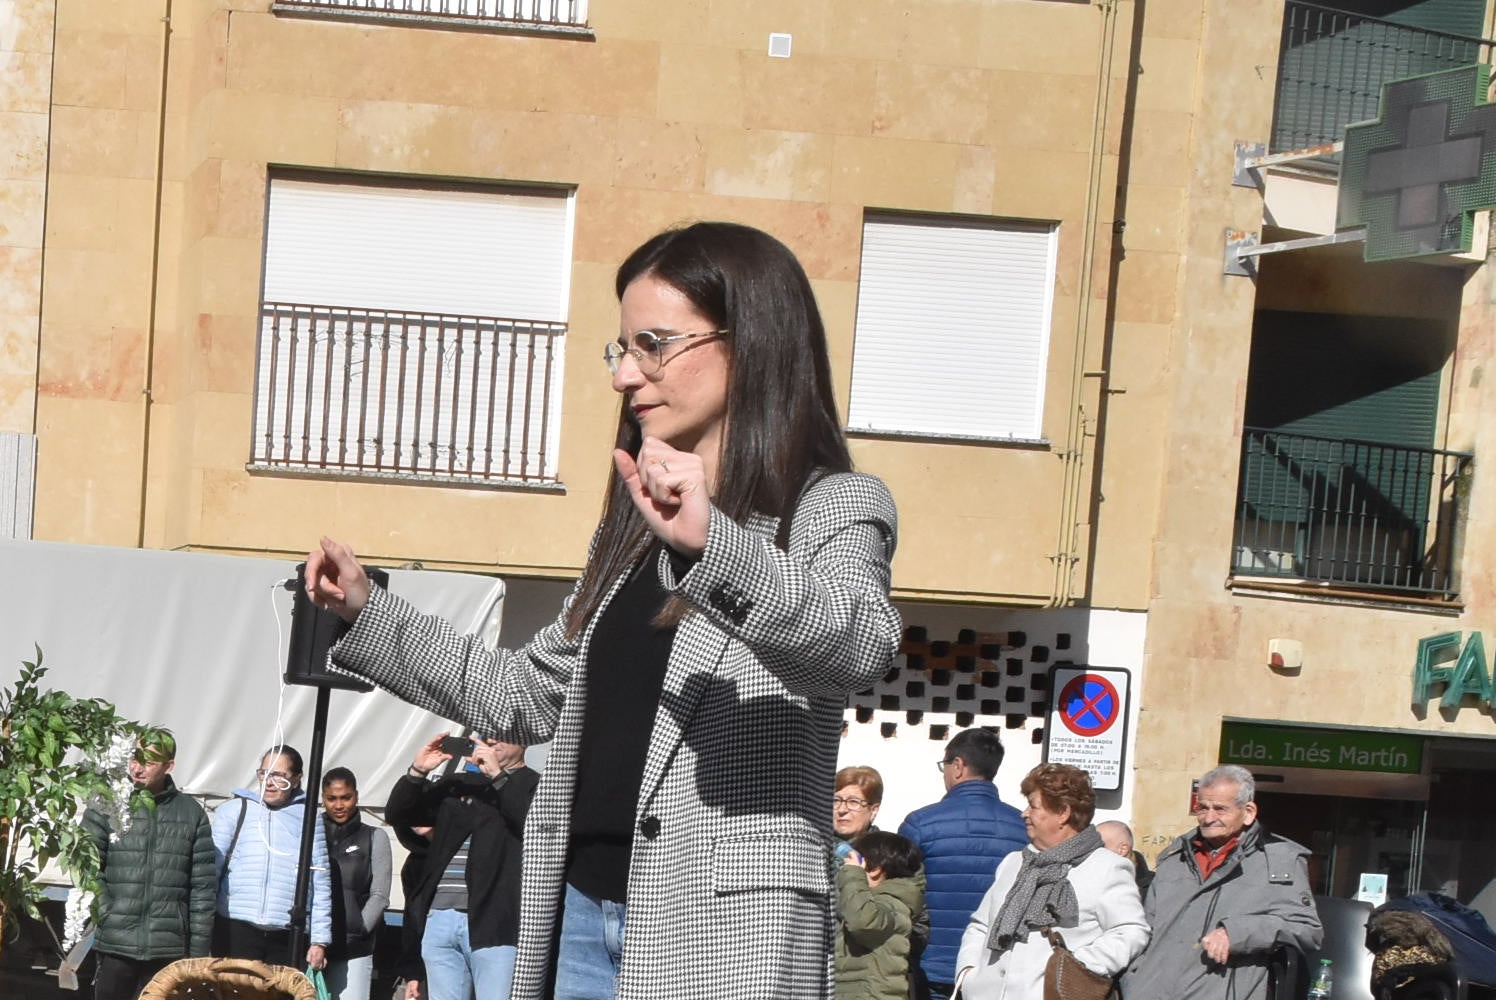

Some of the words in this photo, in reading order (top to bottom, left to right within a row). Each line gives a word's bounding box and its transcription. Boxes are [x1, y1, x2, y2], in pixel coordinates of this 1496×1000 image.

[1411, 630, 1496, 709] FA
[1228, 740, 1273, 760] Lda.
[1282, 742, 1331, 763] Inés
[1338, 745, 1409, 768] Martín
